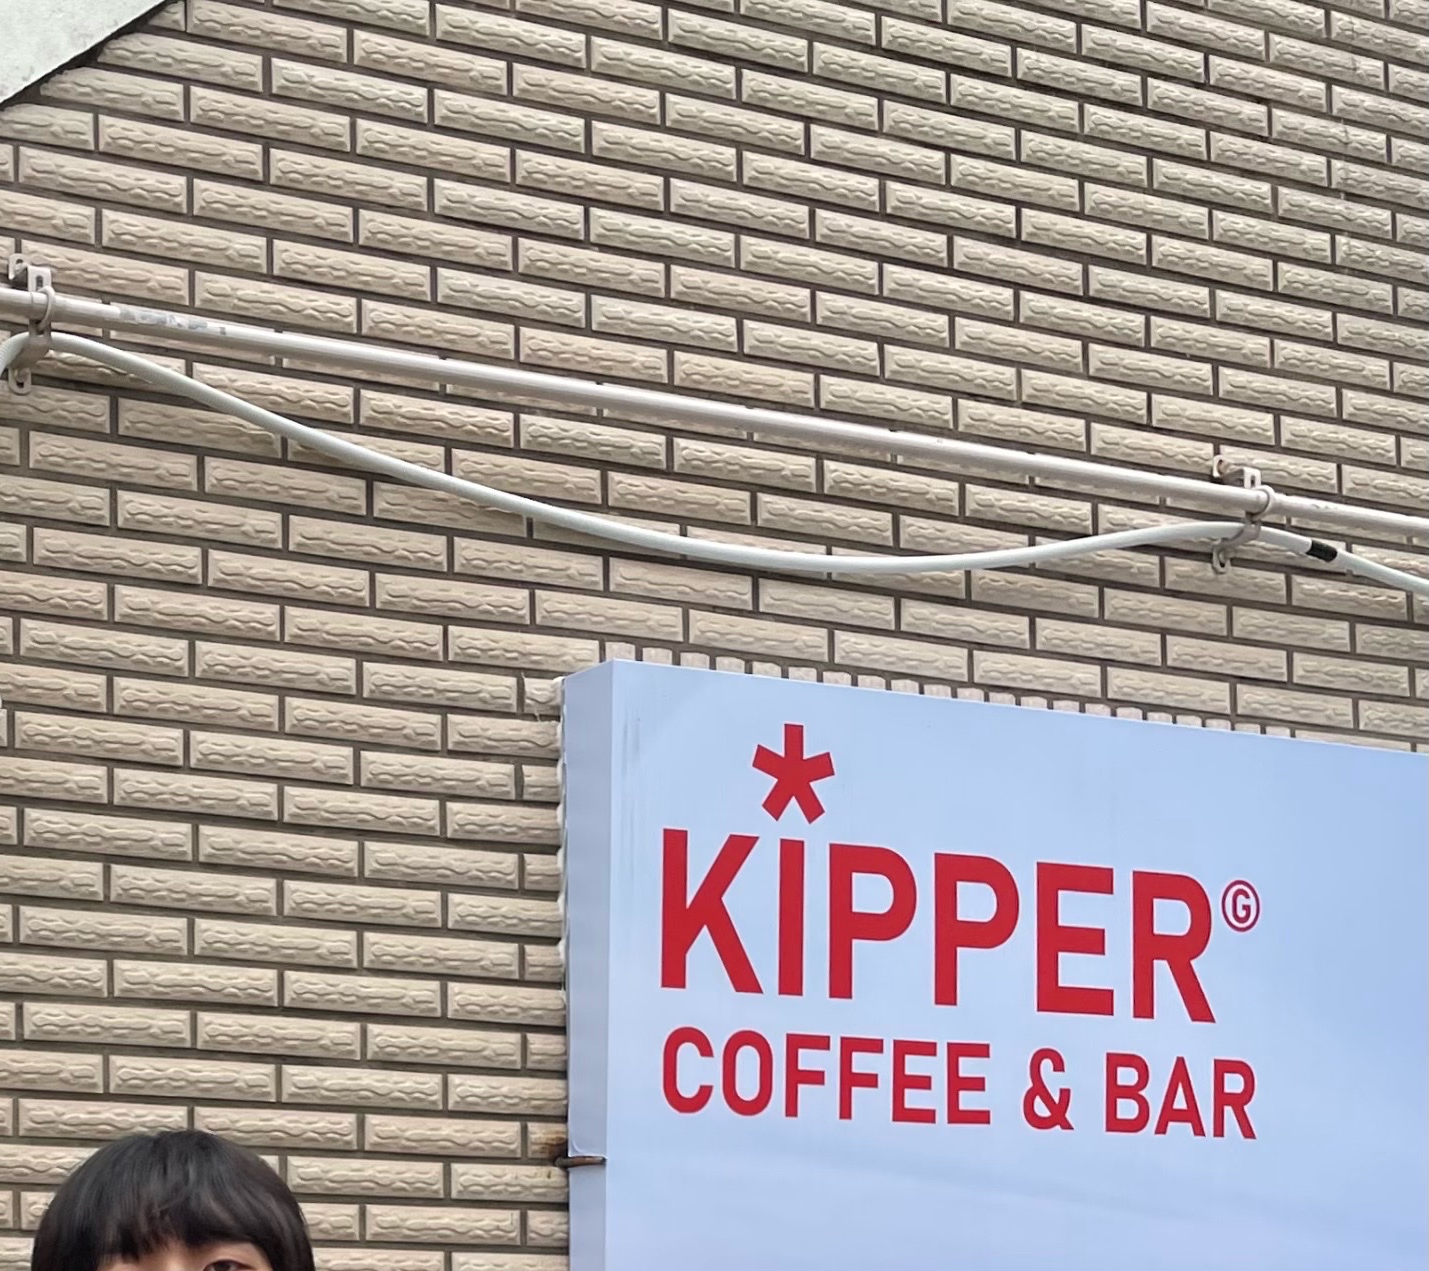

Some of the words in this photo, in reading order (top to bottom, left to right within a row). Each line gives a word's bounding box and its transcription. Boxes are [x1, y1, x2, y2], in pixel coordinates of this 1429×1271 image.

[660, 828, 1216, 1024] KIPPER
[661, 1025, 992, 1126] COFFEE
[1021, 1047, 1074, 1132] &
[1104, 1051, 1258, 1140] BAR
